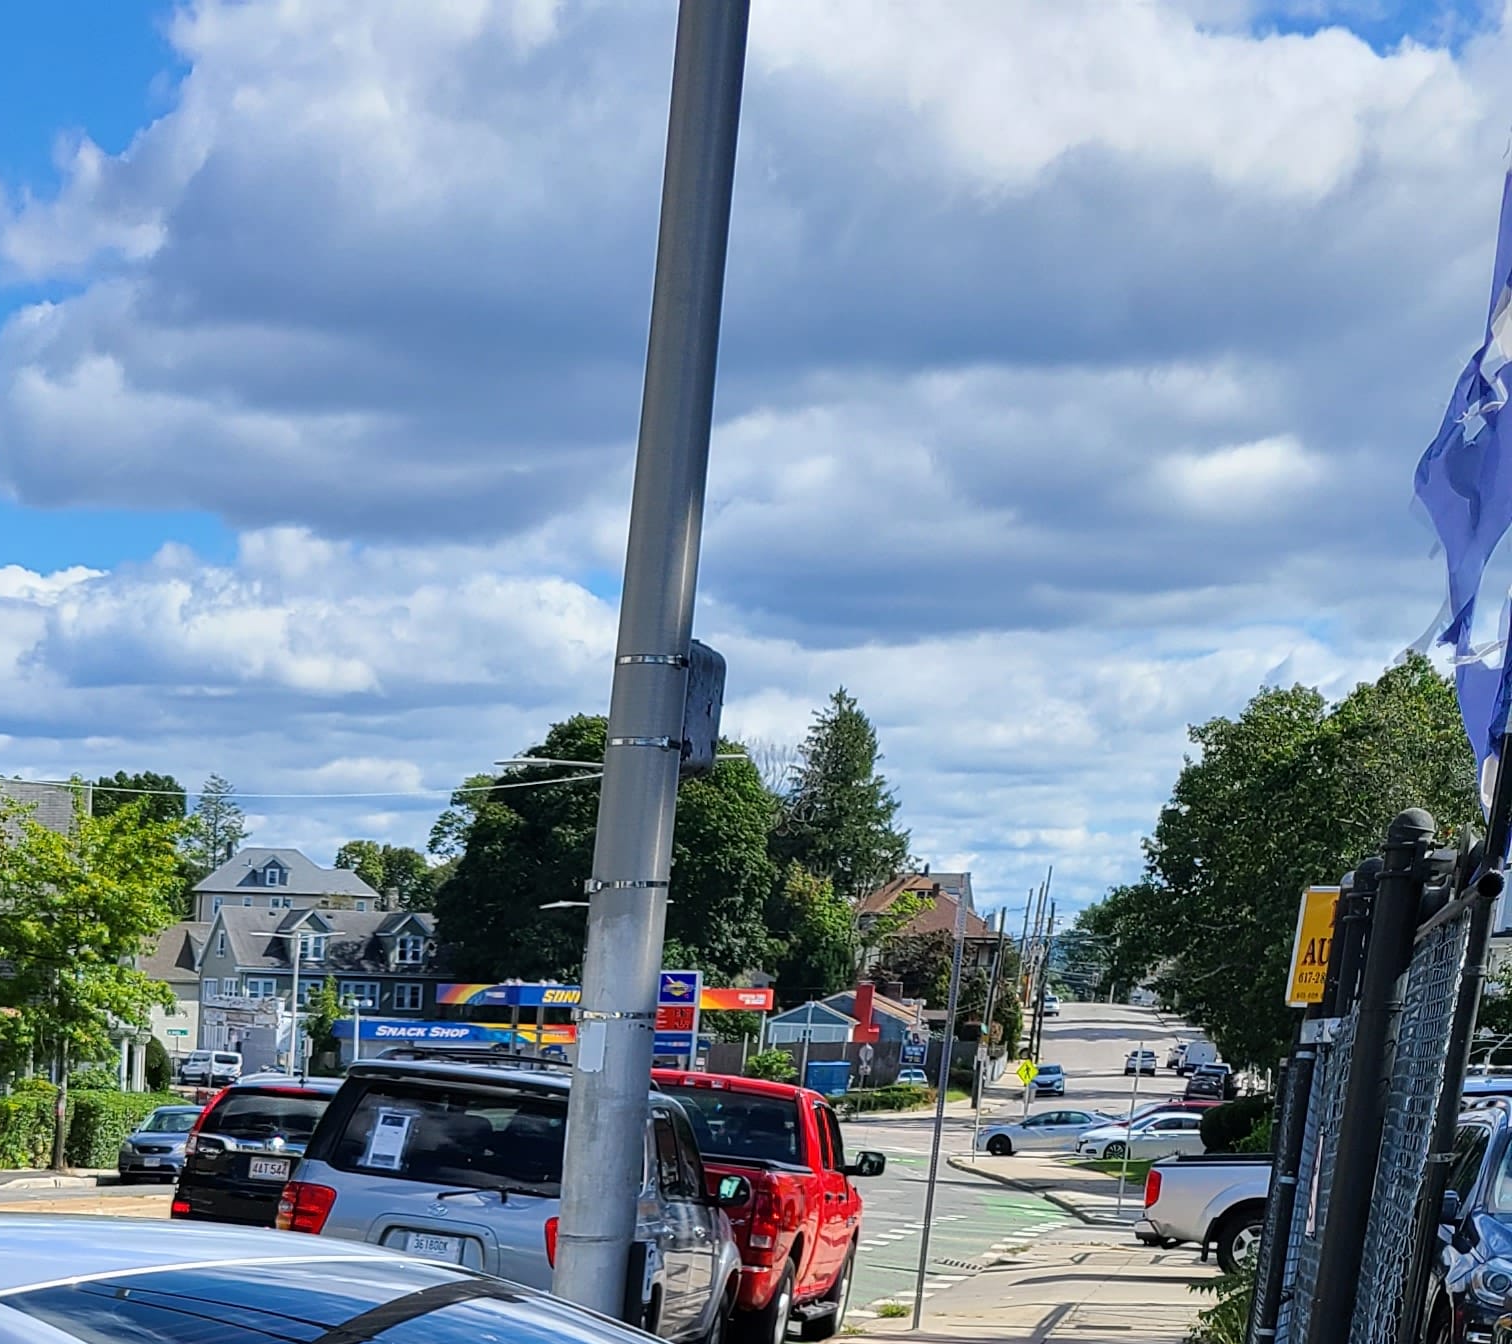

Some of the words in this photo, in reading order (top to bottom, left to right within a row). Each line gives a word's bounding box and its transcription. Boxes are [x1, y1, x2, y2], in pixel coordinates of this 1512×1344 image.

[1301, 938, 1332, 966] AU
[375, 1025, 427, 1037] SNACK
[429, 1027, 469, 1038] SHOP
